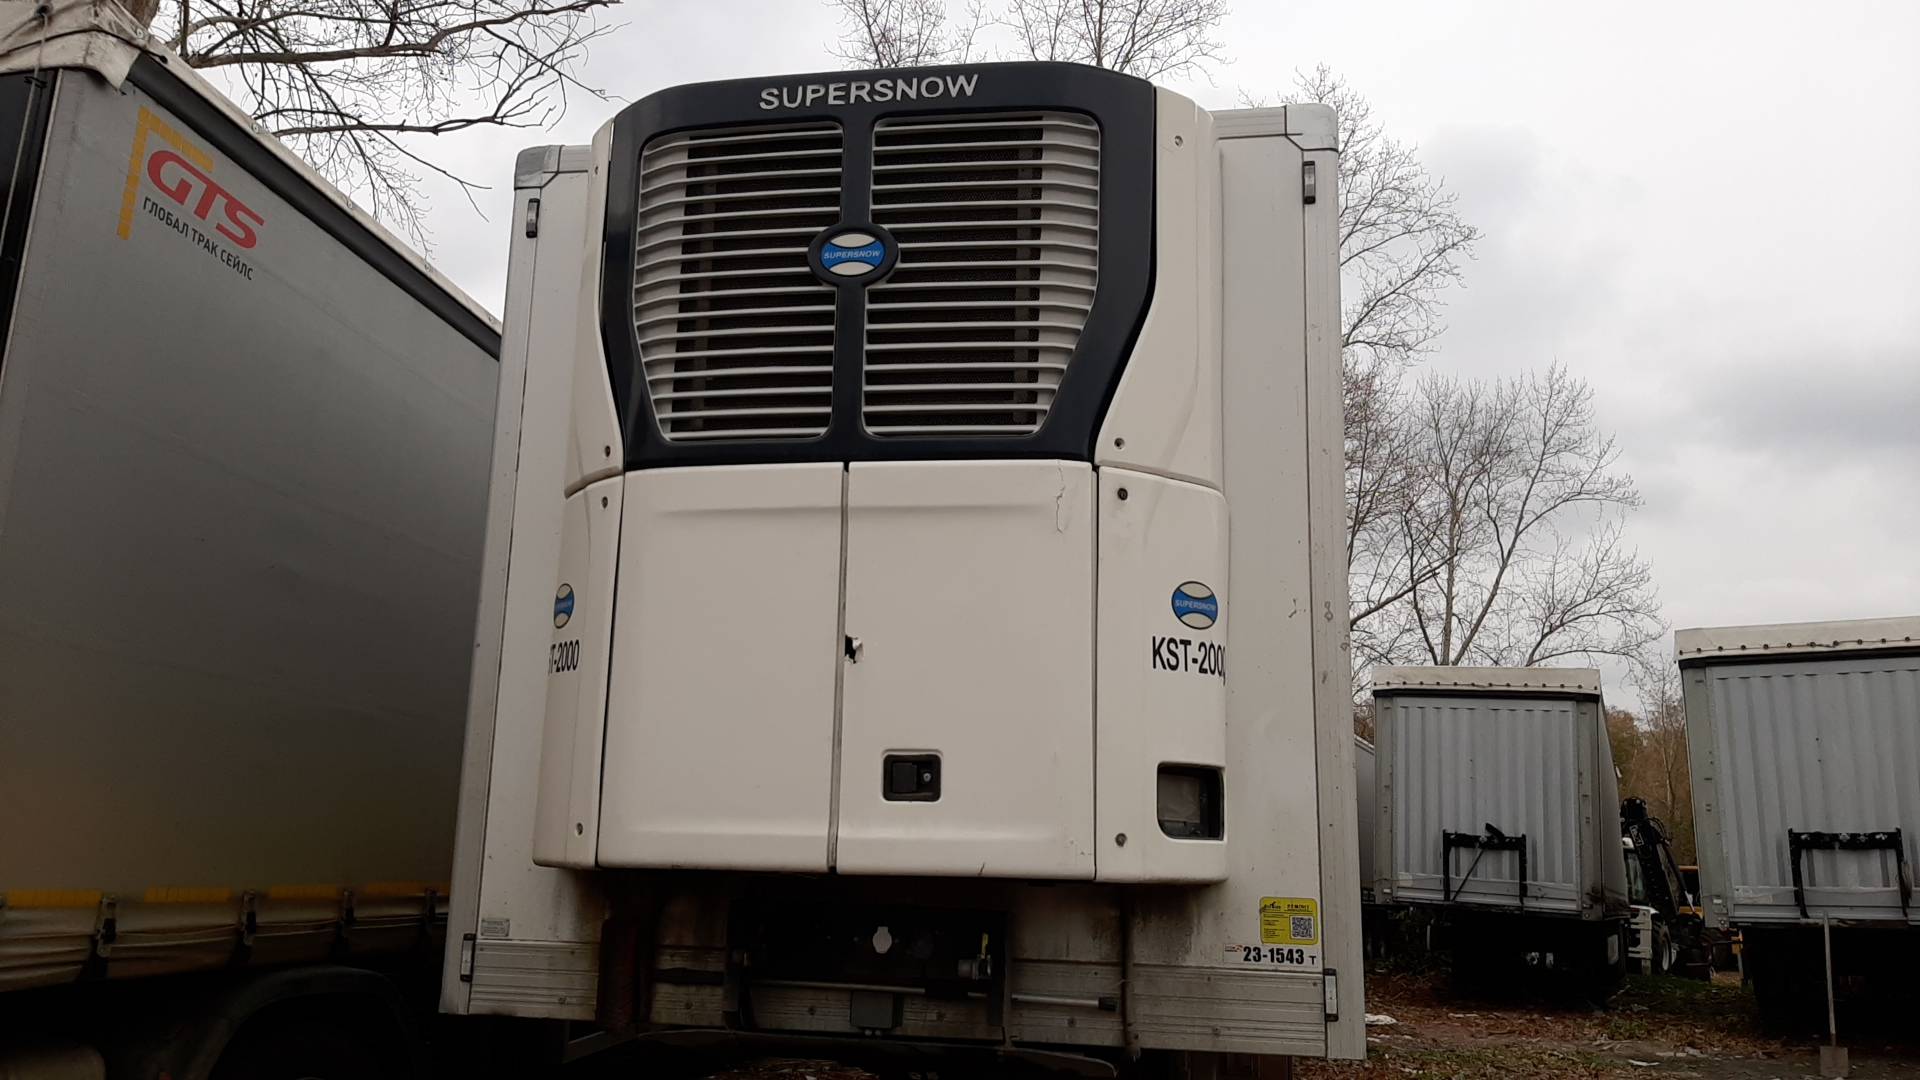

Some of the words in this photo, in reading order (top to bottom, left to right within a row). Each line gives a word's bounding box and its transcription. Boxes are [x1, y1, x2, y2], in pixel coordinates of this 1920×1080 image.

[759, 74, 978, 110] SUPERSNOW
[147, 150, 265, 249] GTS
[142, 196, 189, 239] ГЛОБАЛ
[191, 228, 219, 258] ТРАК
[220, 249, 254, 280] СЕЙЛС
[823, 249, 881, 260] SUPERSNOW
[547, 639, 580, 676] T-2000
[1243, 946, 1305, 965] 23-1543
